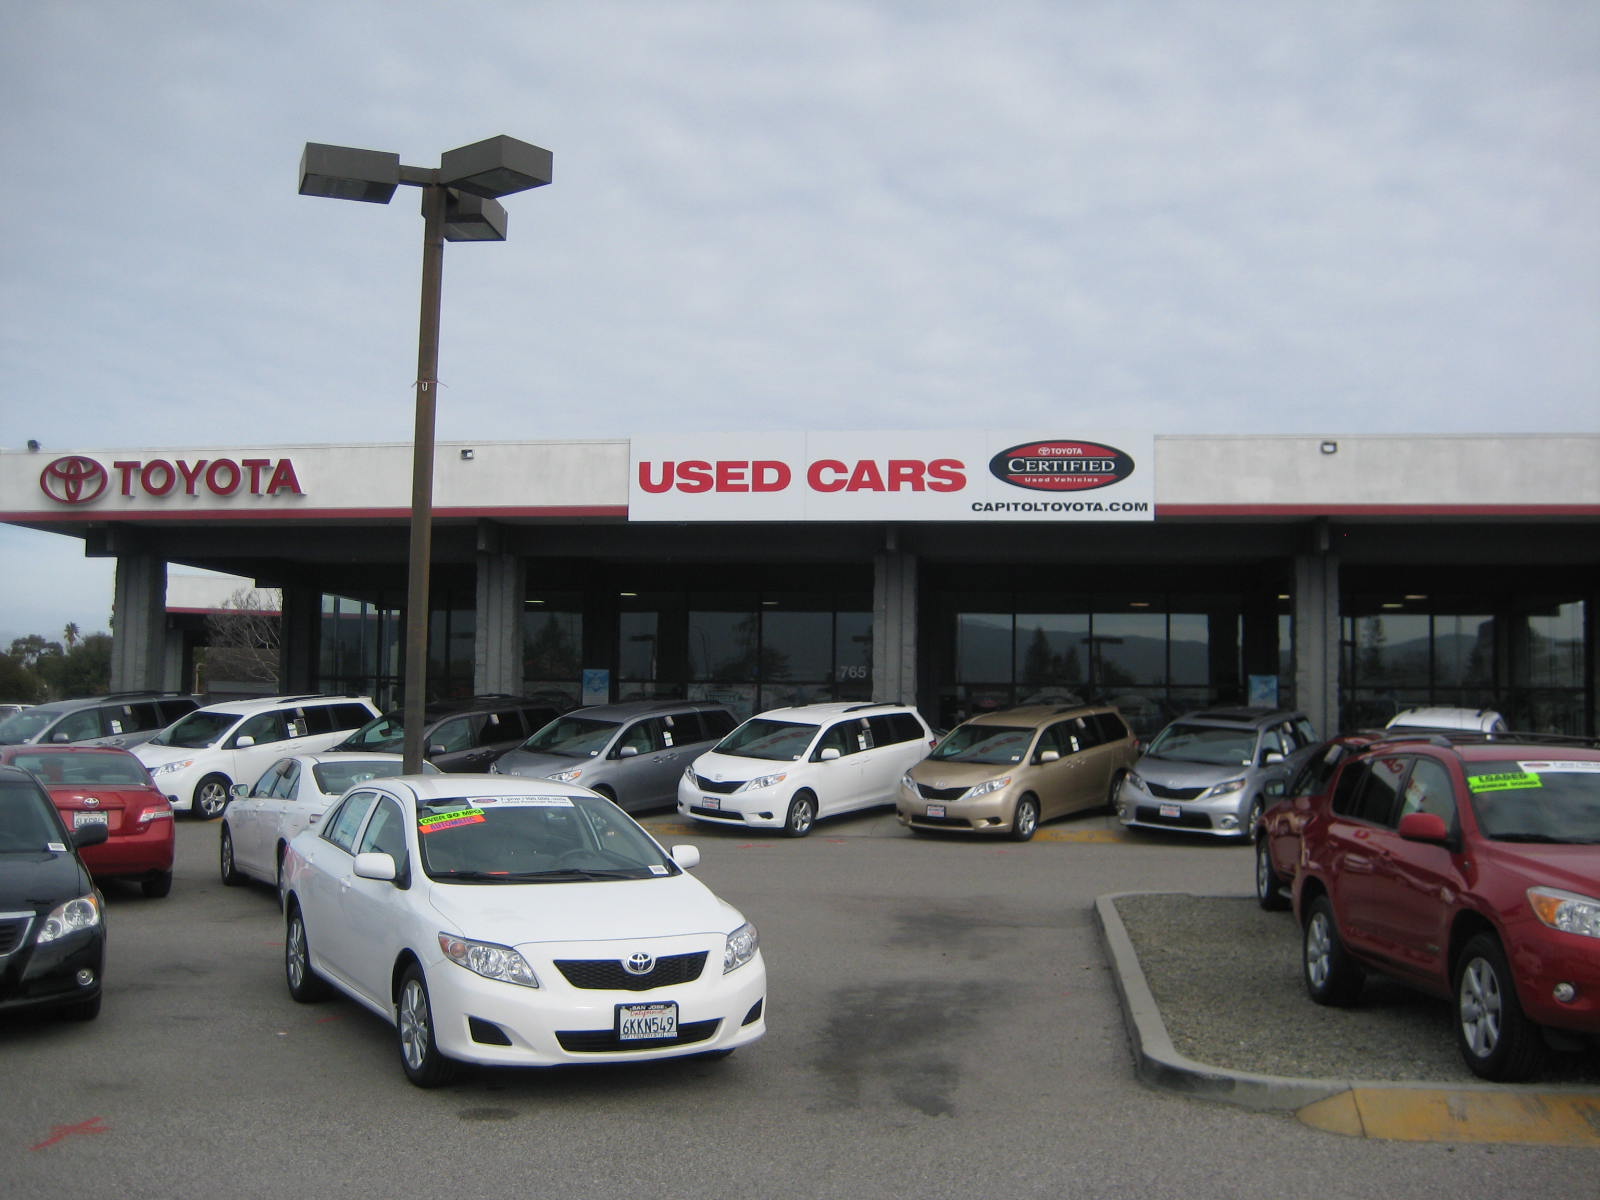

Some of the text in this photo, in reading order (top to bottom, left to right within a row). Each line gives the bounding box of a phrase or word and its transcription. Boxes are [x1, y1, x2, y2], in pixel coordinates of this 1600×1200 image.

[1050, 447, 1083, 455] TOYOTA
[1008, 458, 1115, 472] CERTIFIED
[113, 458, 302, 496] TOYOTA
[638, 458, 967, 494] USED CARS
[971, 502, 1148, 512] CAPITOLTOYOTA.COM
[840, 665, 867, 679] 765
[421, 815, 446, 824] OVER
[622, 1017, 674, 1035] 6KKN549
